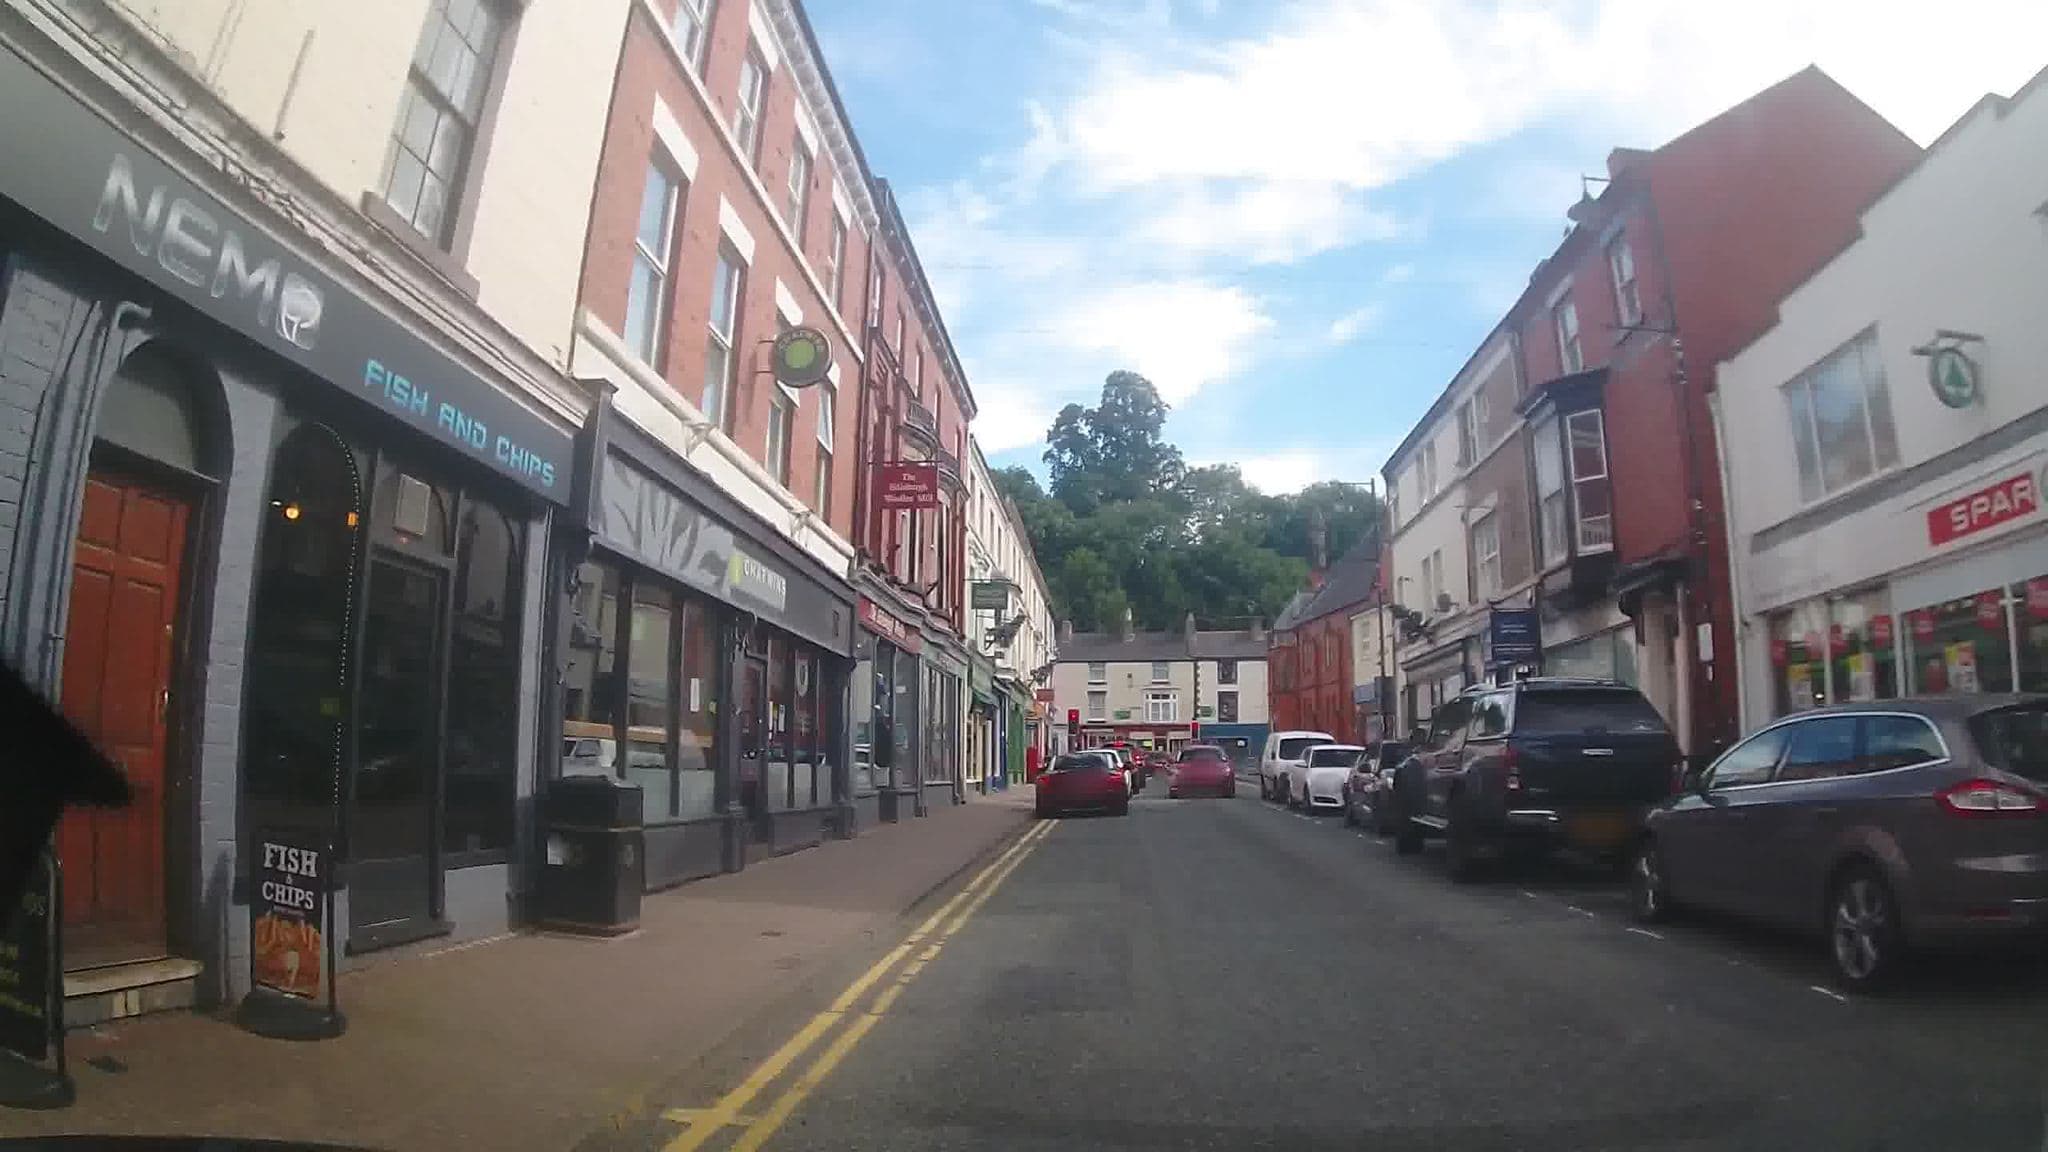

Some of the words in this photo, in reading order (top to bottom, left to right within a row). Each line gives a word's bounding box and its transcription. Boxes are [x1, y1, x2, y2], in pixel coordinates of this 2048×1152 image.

[92, 153, 323, 351] NEMO
[364, 359, 428, 416] FISH
[439, 402, 487, 449] AND
[496, 435, 556, 487] CHIPS
[1950, 479, 2034, 532] SPAR
[264, 842, 319, 877] FISH
[262, 881, 314, 910] CHIPS
